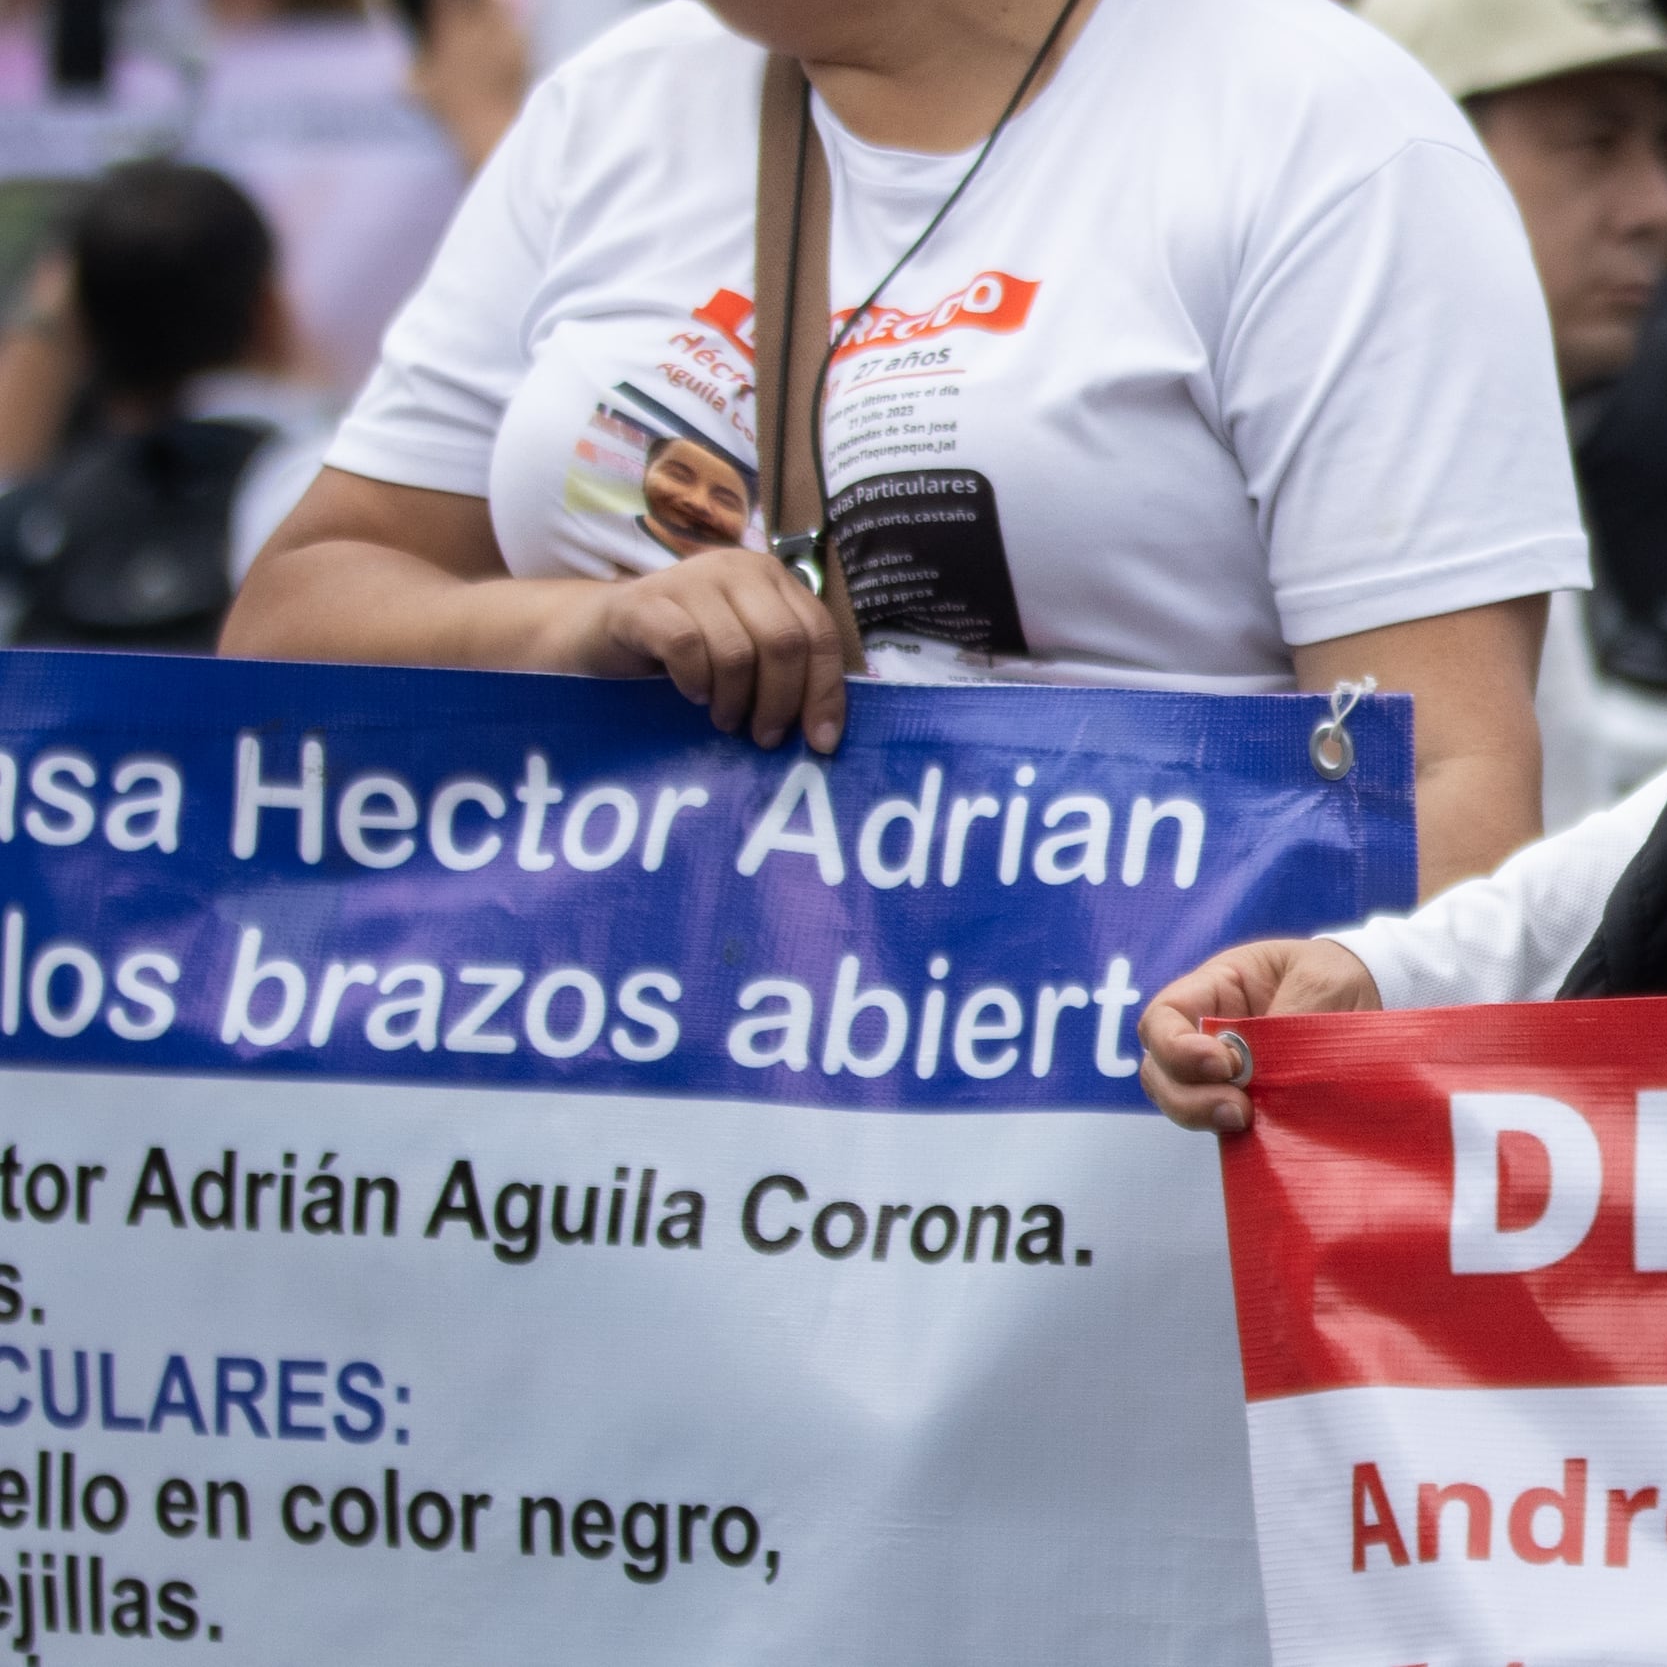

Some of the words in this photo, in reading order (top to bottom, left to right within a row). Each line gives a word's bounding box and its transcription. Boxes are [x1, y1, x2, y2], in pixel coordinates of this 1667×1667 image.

[883, 346, 953, 374] años
[903, 422, 926, 435] San
[856, 475, 979, 505] Particulares
[231, 736, 709, 873] Hector
[736, 762, 1205, 890] Adrian
[2, 909, 181, 1041] los
[221, 928, 681, 1062] brazos
[727, 955, 1145, 1080] abiert
[126, 1147, 400, 1237] Adrián
[423, 1159, 706, 1265] Aguila
[740, 1174, 1094, 1267] Corona.
[155, 1474, 252, 1540] en
[281, 1469, 491, 1552] color
[519, 1492, 781, 1585] negro,
